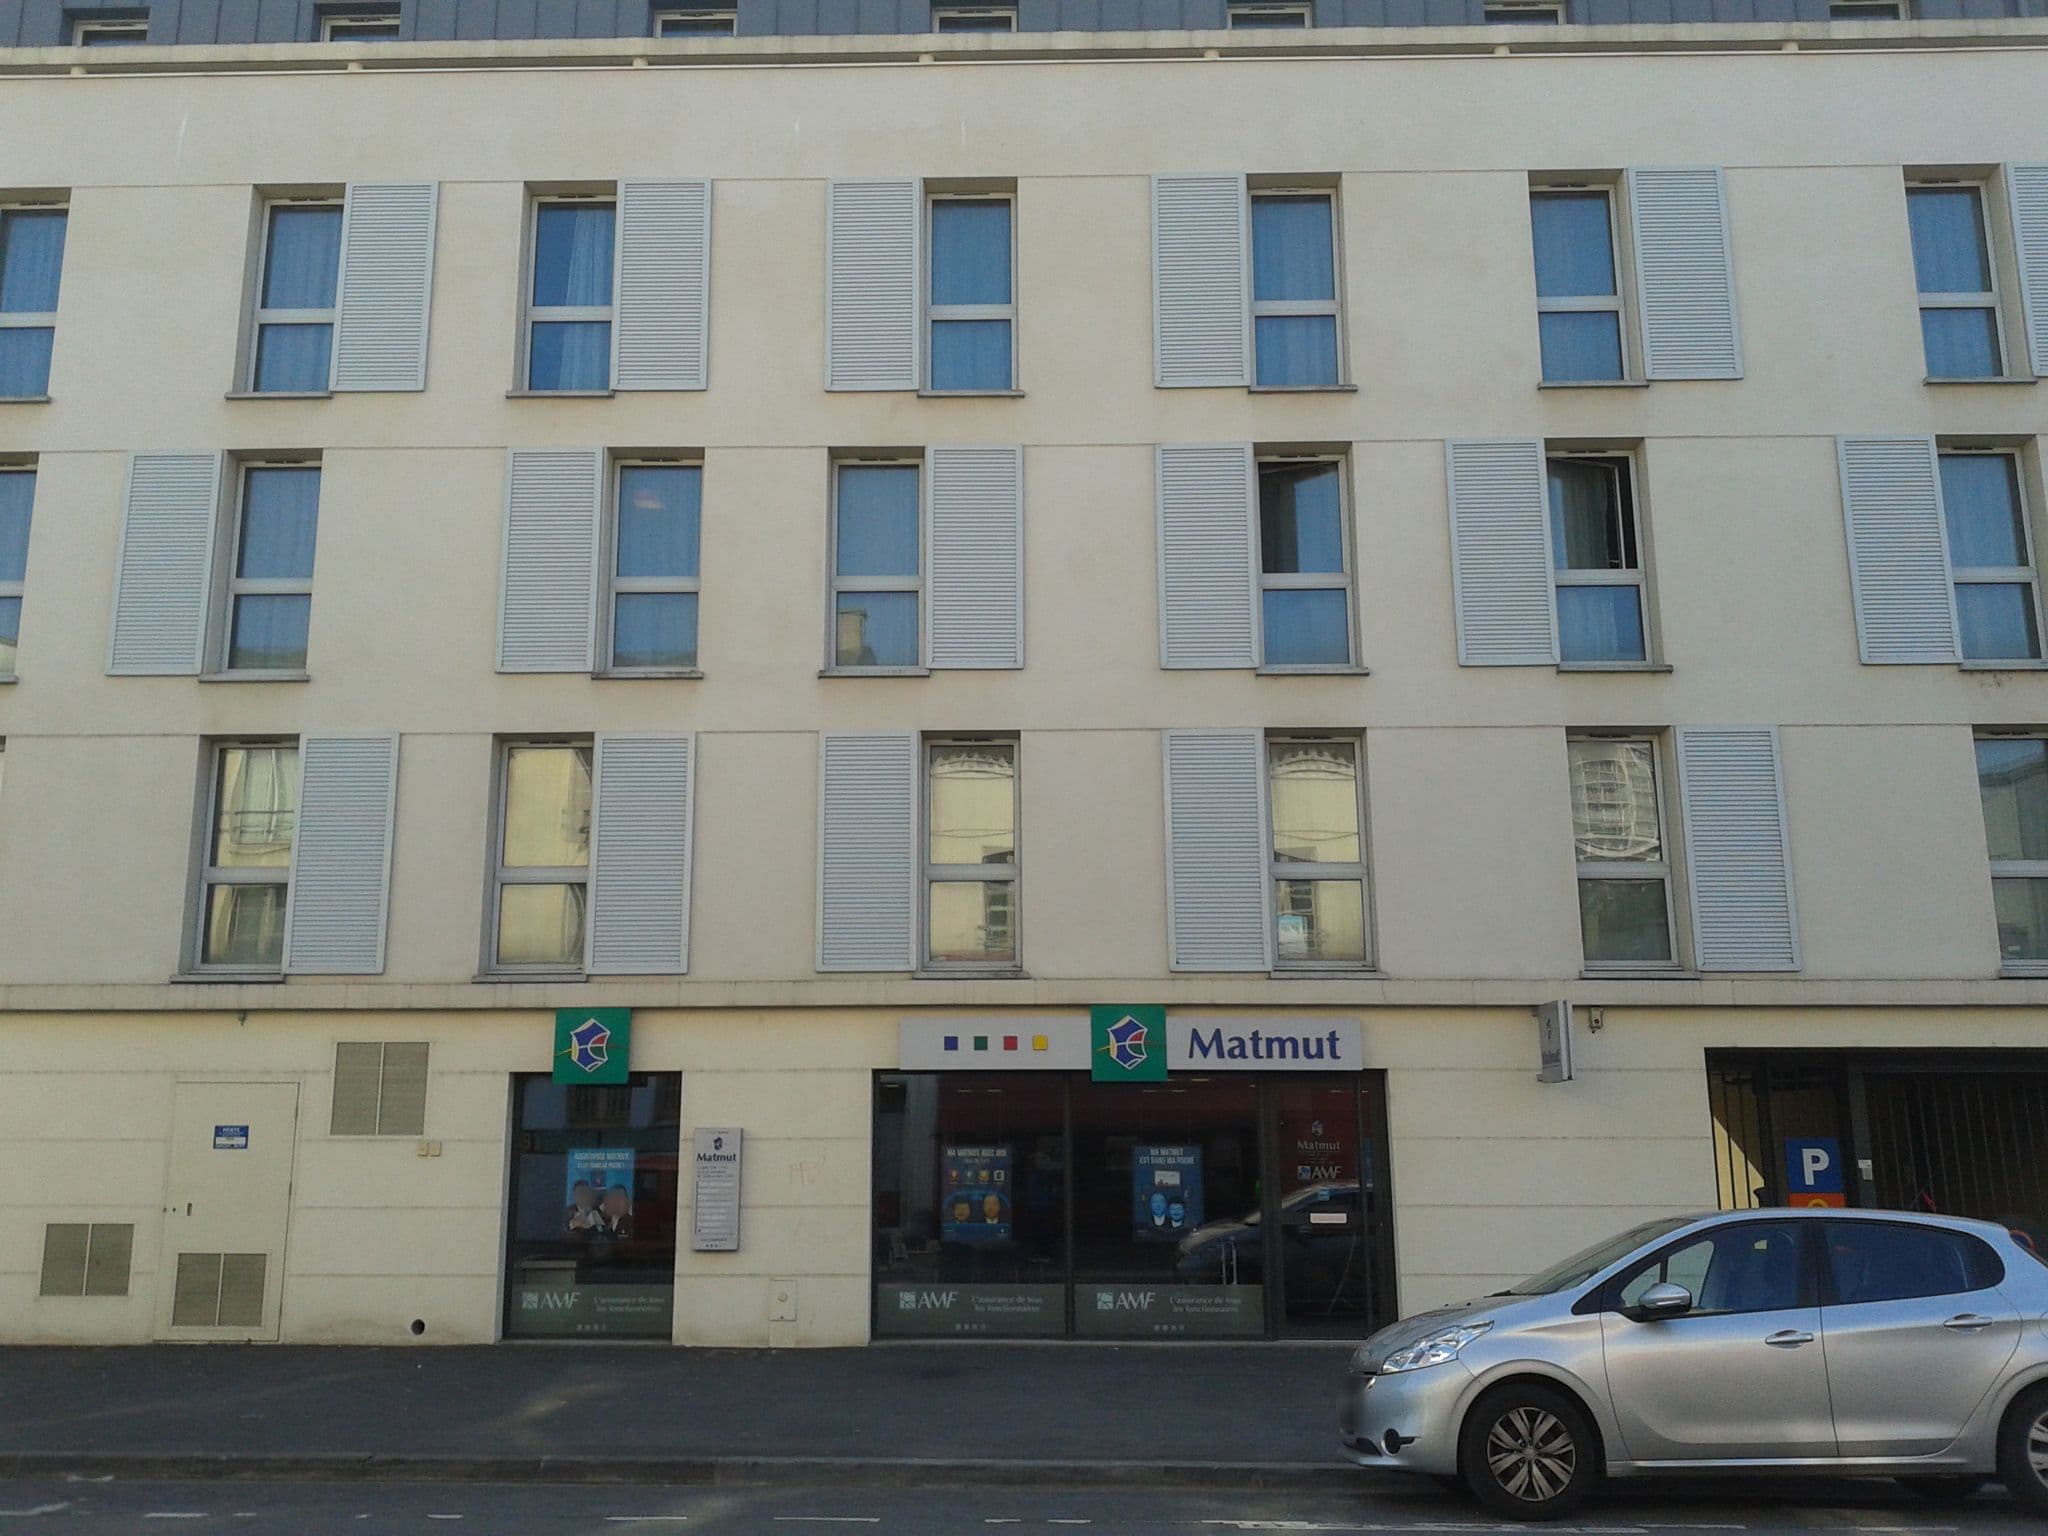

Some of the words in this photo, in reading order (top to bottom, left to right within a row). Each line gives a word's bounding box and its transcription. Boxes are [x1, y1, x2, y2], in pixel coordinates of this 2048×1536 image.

[1188, 1028, 1342, 1060] Matmut
[1297, 1141, 1341, 1151] Matmut
[696, 1152, 737, 1162] Matmut
[1311, 1166, 1342, 1179] AMF
[1802, 1148, 1830, 1185] P
[540, 1291, 581, 1310] AMF
[917, 1291, 959, 1309] AMF
[1115, 1292, 1156, 1310] AMF
